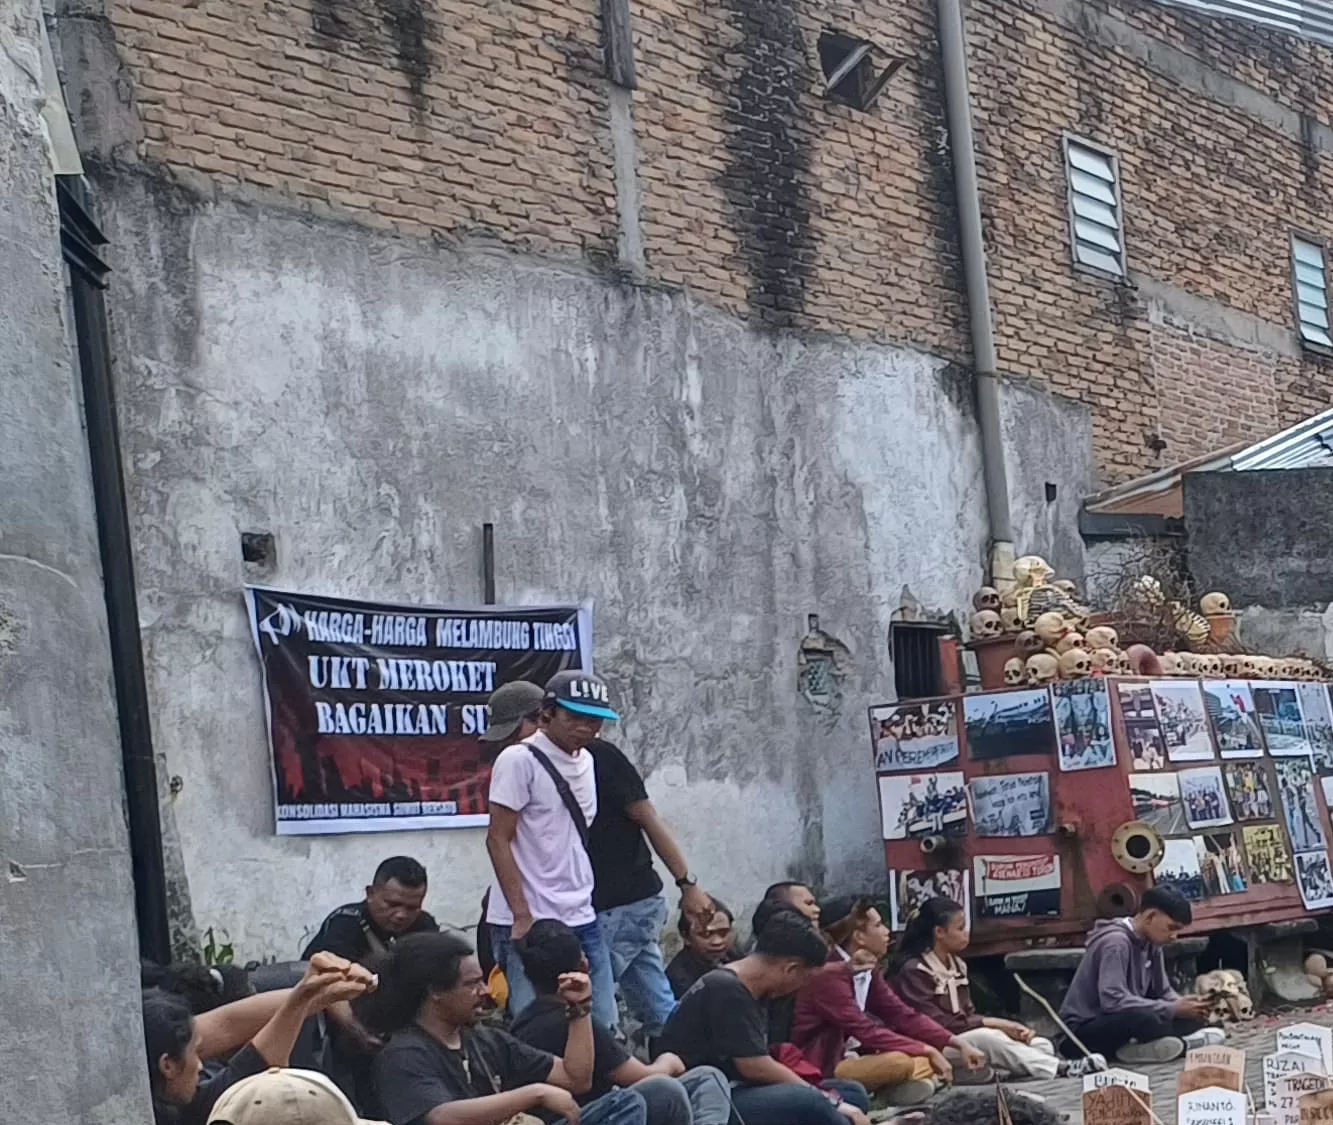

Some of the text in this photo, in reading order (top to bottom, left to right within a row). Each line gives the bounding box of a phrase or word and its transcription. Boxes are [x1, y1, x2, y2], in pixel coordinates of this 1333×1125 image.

[303, 610, 427, 647] HARGA-HARGA
[436, 618, 530, 650] MELAMBUNG
[308, 655, 497, 692] UKT MEROKET
[316, 702, 448, 735] BAGAIKAN
